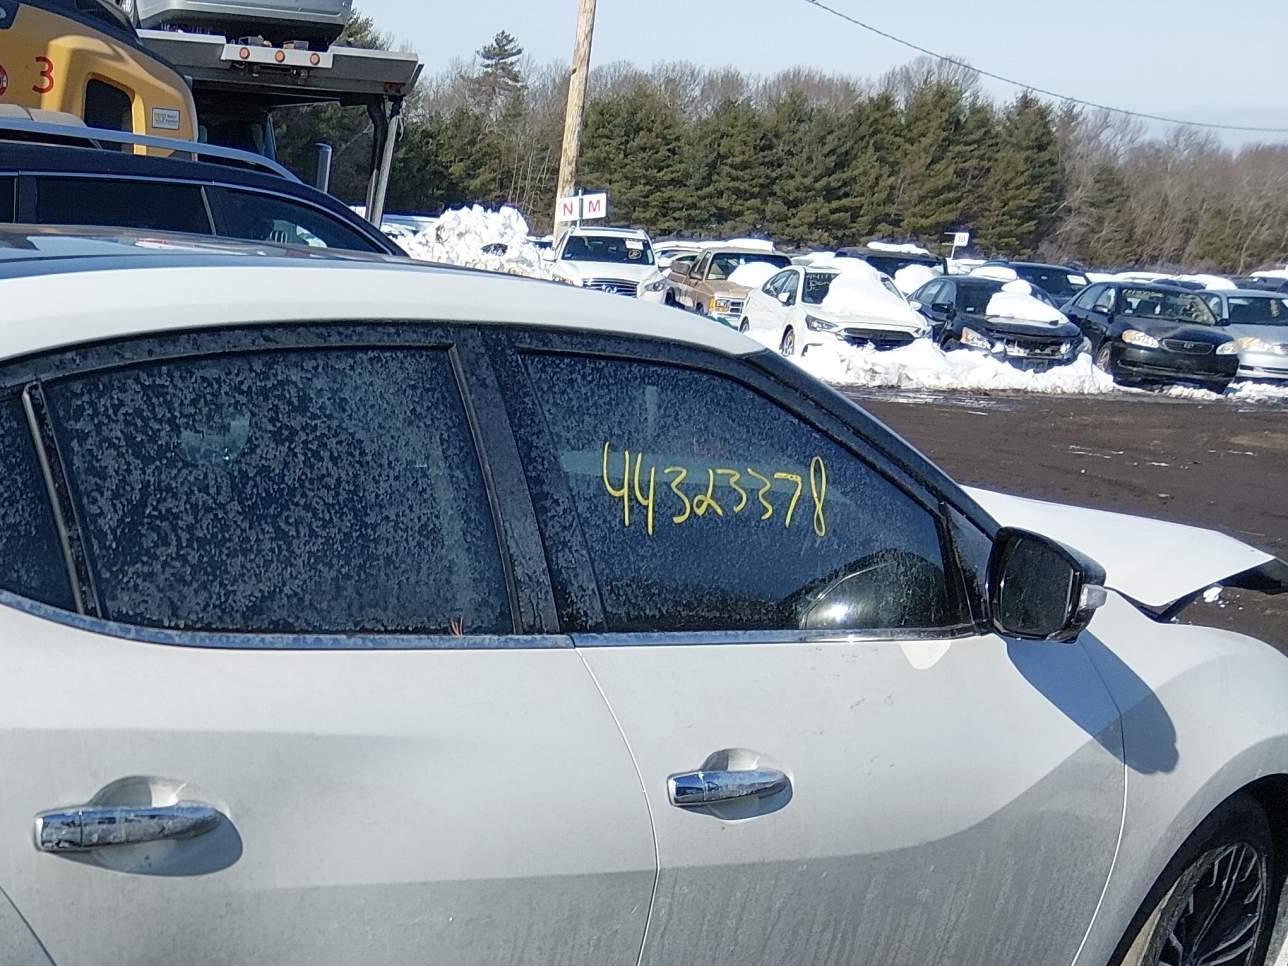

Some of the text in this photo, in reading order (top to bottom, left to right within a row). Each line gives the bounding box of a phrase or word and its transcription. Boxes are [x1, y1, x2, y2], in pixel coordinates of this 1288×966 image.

[31, 56, 55, 95] 3
[562, 201, 574, 217] N
[587, 199, 602, 214] M
[602, 441, 829, 538] 44323378
